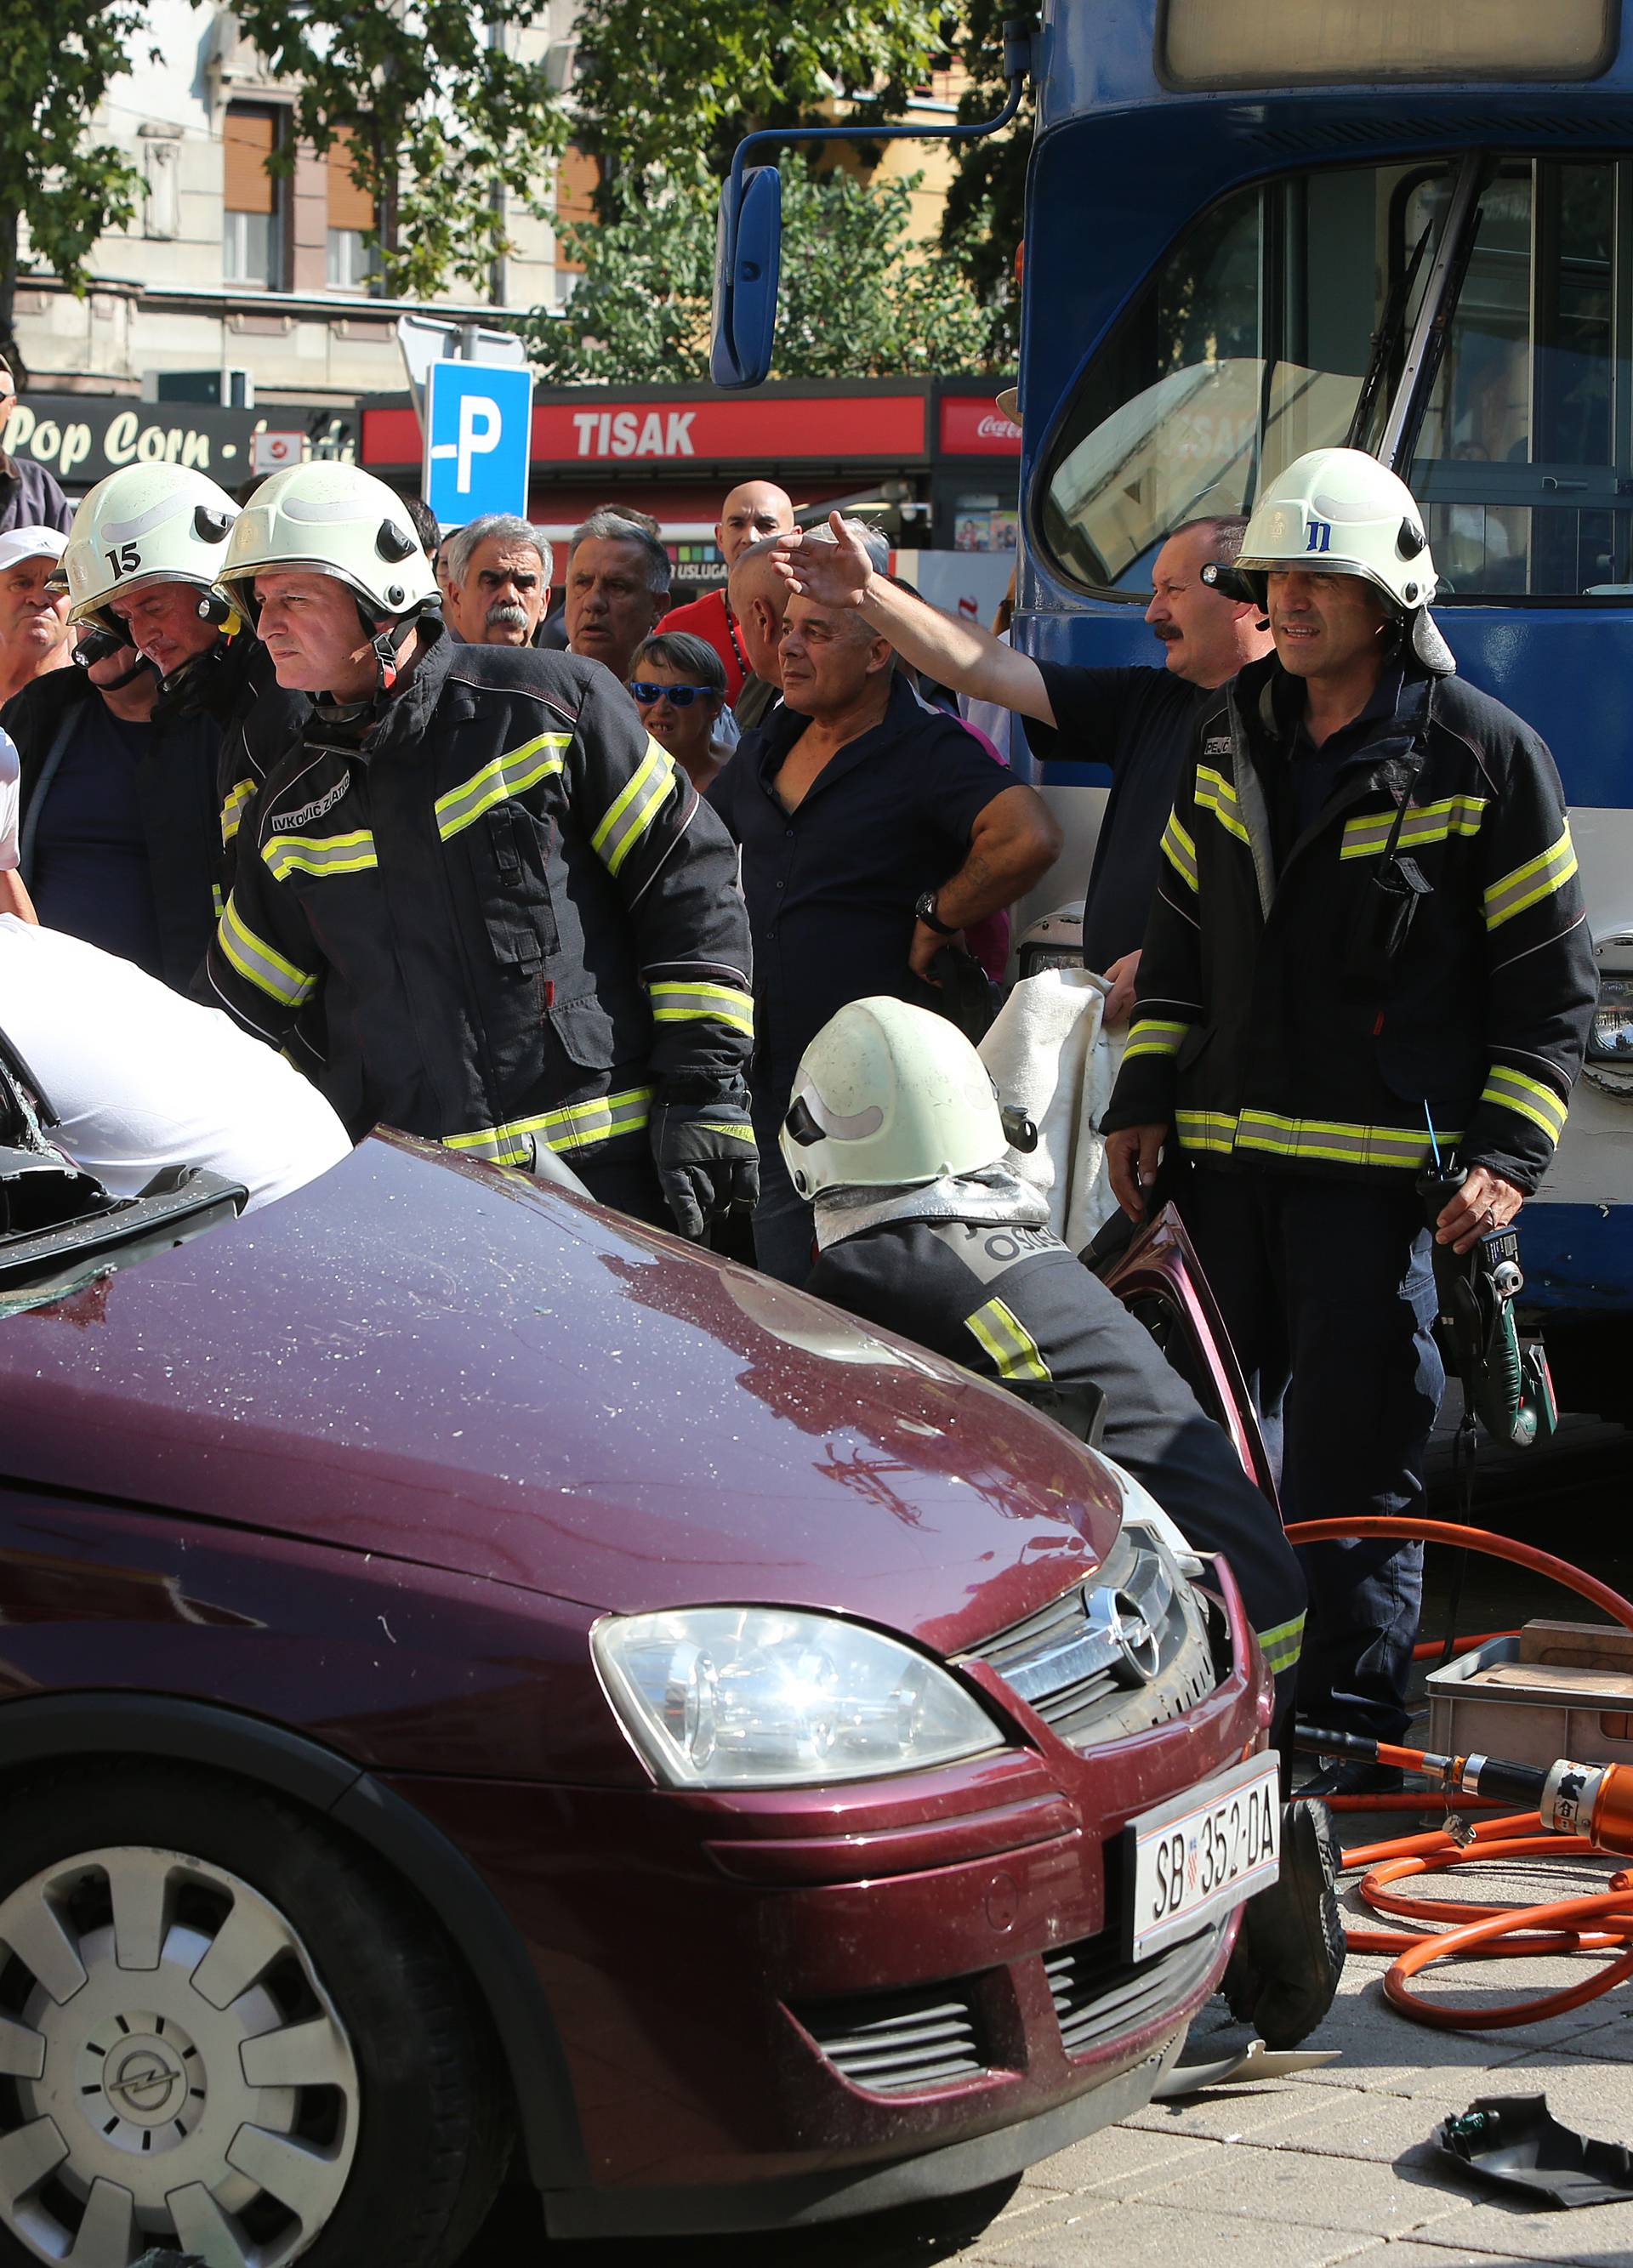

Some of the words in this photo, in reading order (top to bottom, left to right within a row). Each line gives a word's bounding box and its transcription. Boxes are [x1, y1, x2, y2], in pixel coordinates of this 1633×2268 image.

[3, 405, 92, 475] Pop
[104, 411, 210, 468] Corn
[457, 395, 502, 493] P
[573, 412, 697, 456] TISAK
[105, 542, 141, 581] 15
[273, 802, 321, 830] IVKOVIĆ
[1153, 1832, 1185, 1920] SB
